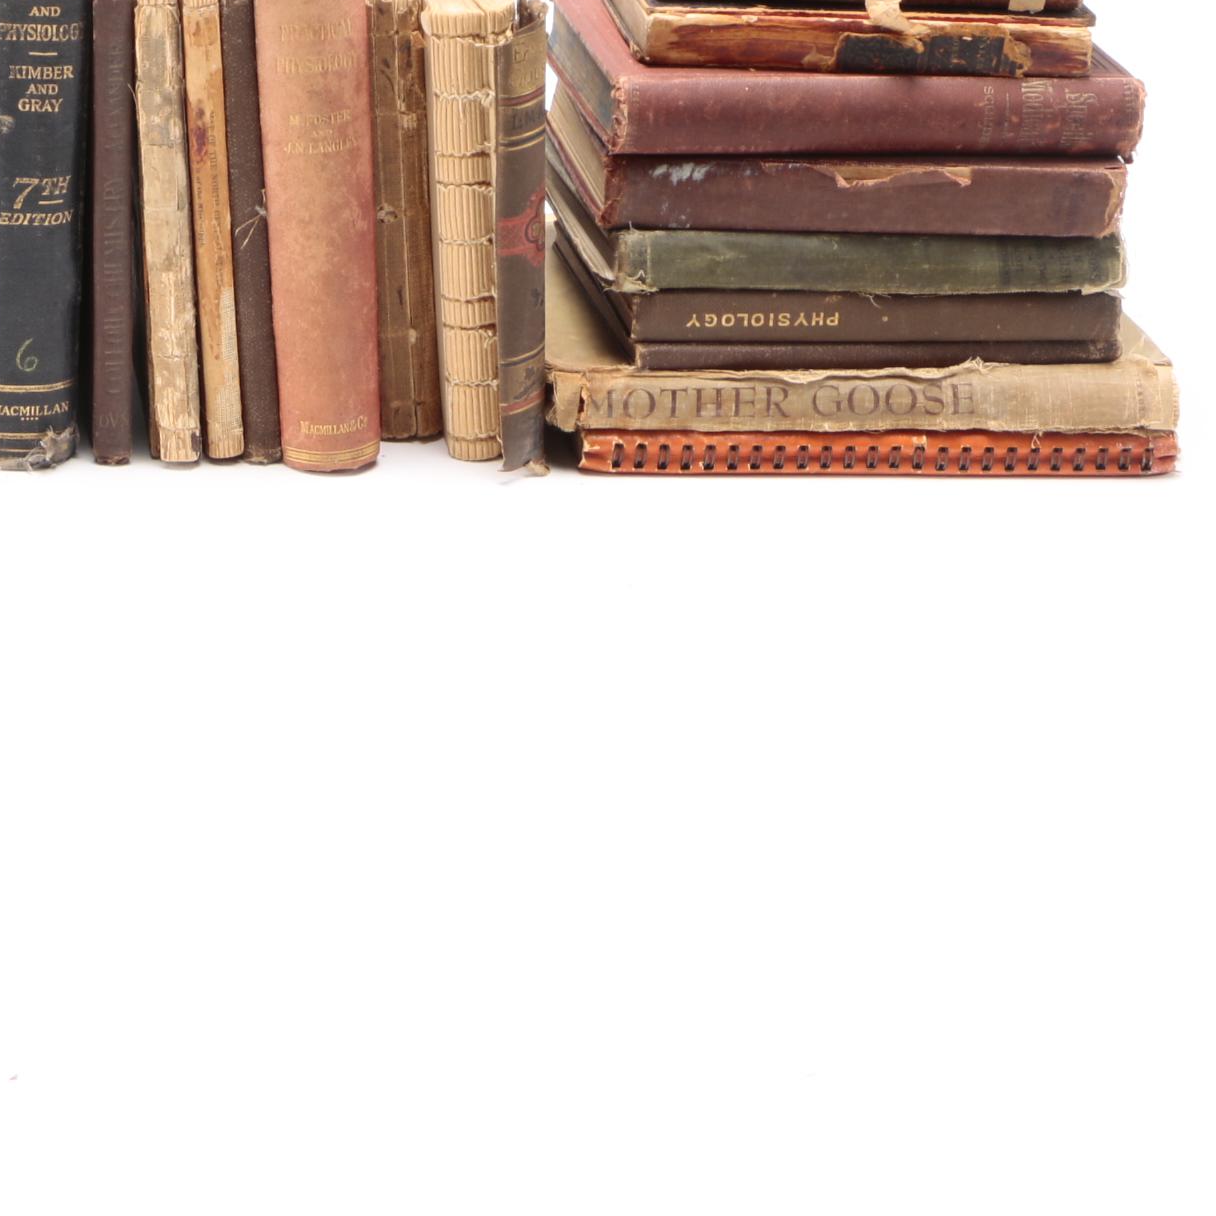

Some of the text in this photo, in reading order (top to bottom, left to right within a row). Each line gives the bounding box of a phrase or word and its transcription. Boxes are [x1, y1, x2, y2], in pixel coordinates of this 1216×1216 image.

[28, 6, 61, 17] AND
[8, 65, 75, 80] KIMBER
[25, 84, 59, 95] AND
[17, 98, 64, 113] GRAY
[686, 312, 841, 328] PHYSIOLOGY
[15, 336, 40, 373] 6
[587, 381, 976, 420] MOTHER GOOSE
